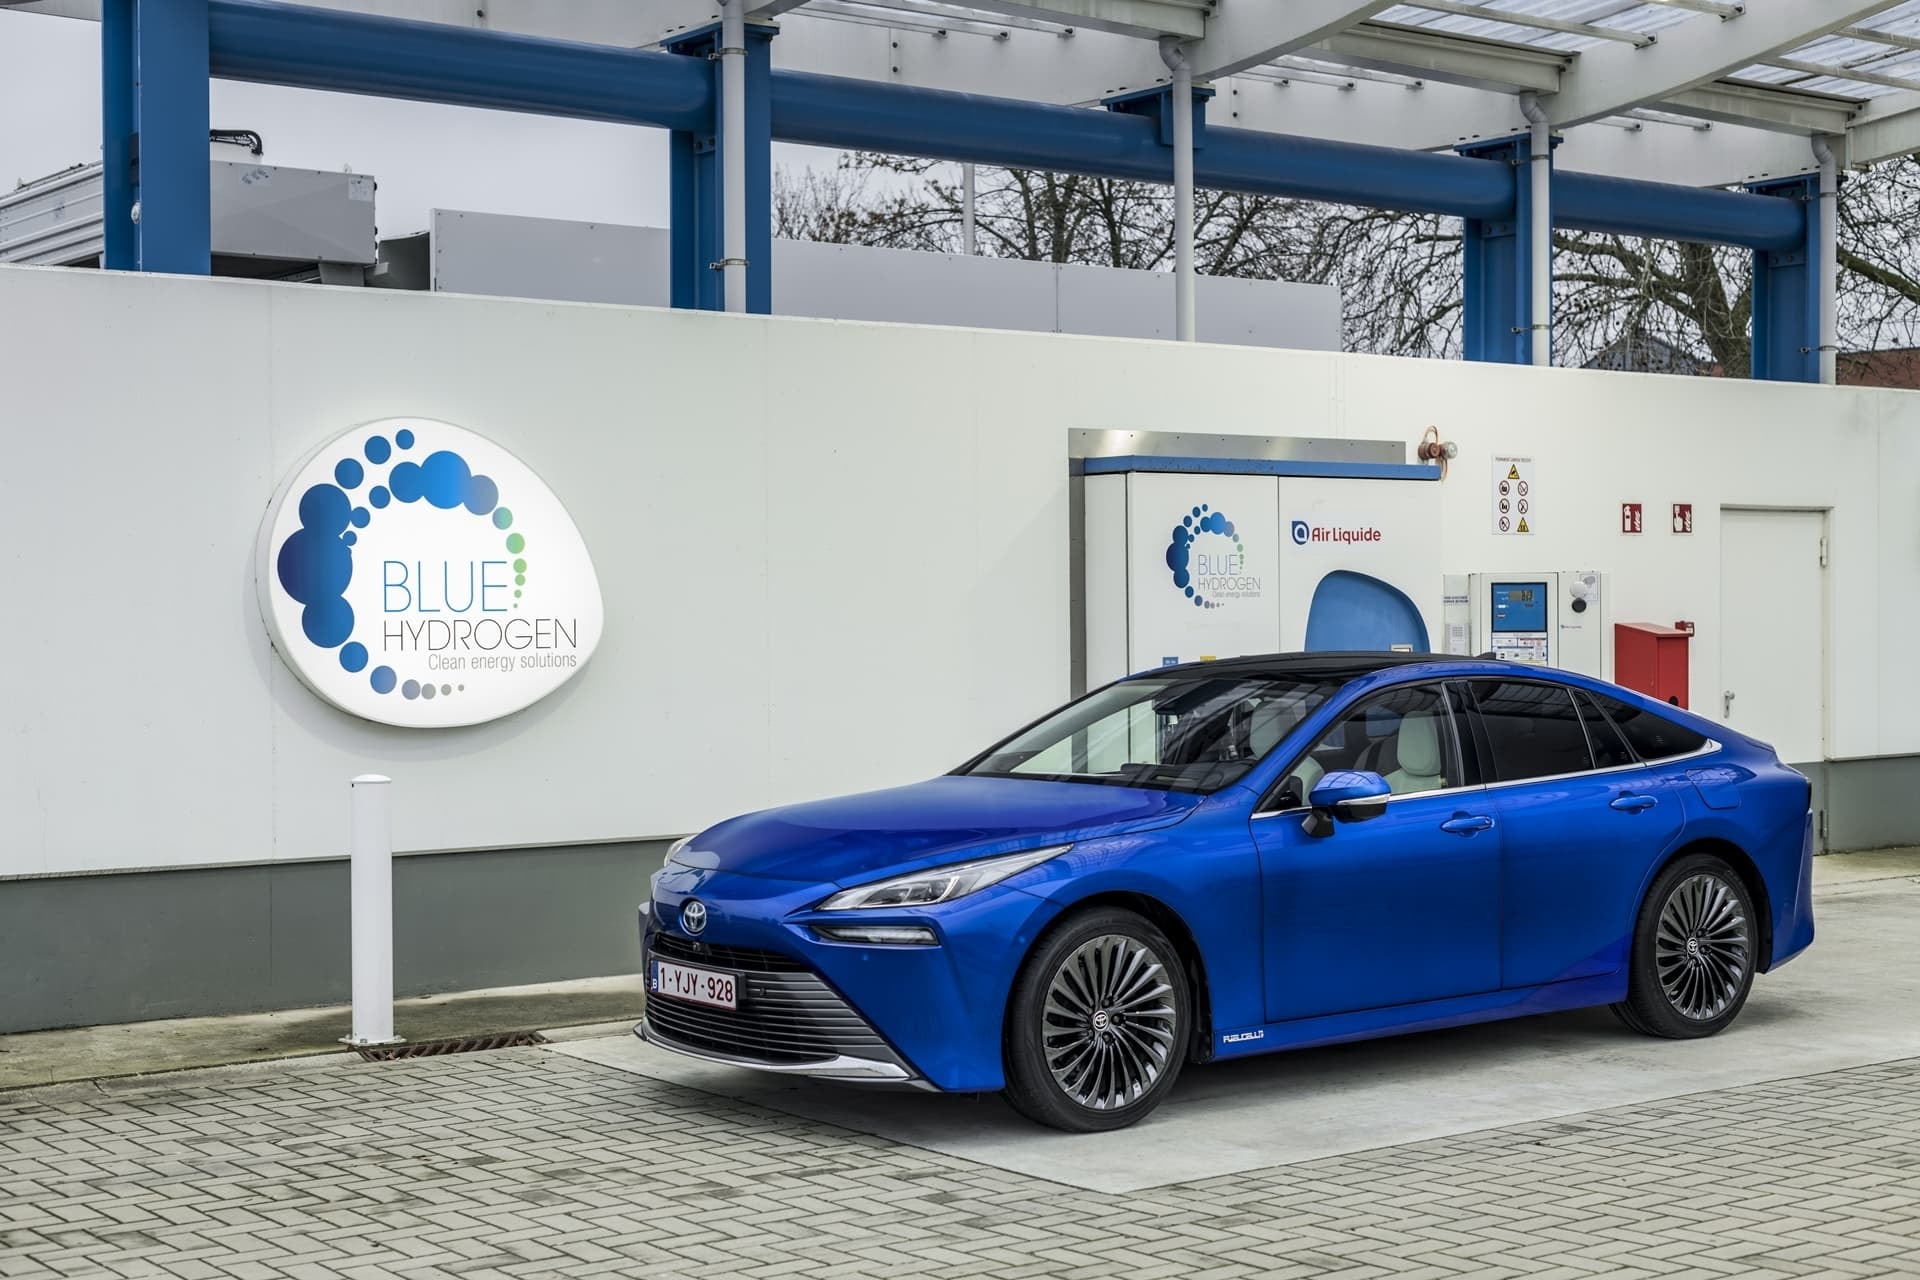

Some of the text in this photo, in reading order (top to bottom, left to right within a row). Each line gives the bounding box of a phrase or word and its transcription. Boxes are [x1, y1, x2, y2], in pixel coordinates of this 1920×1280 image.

[1312, 527, 1381, 545] Air Liquide
[1198, 554, 1238, 575] BLUE
[383, 560, 508, 613] BLUE
[1198, 577, 1261, 591] HYDROGEN
[383, 618, 577, 652] HYDROGEN
[428, 652, 577, 672] Clean energy solutions
[652, 979, 658, 989] B
